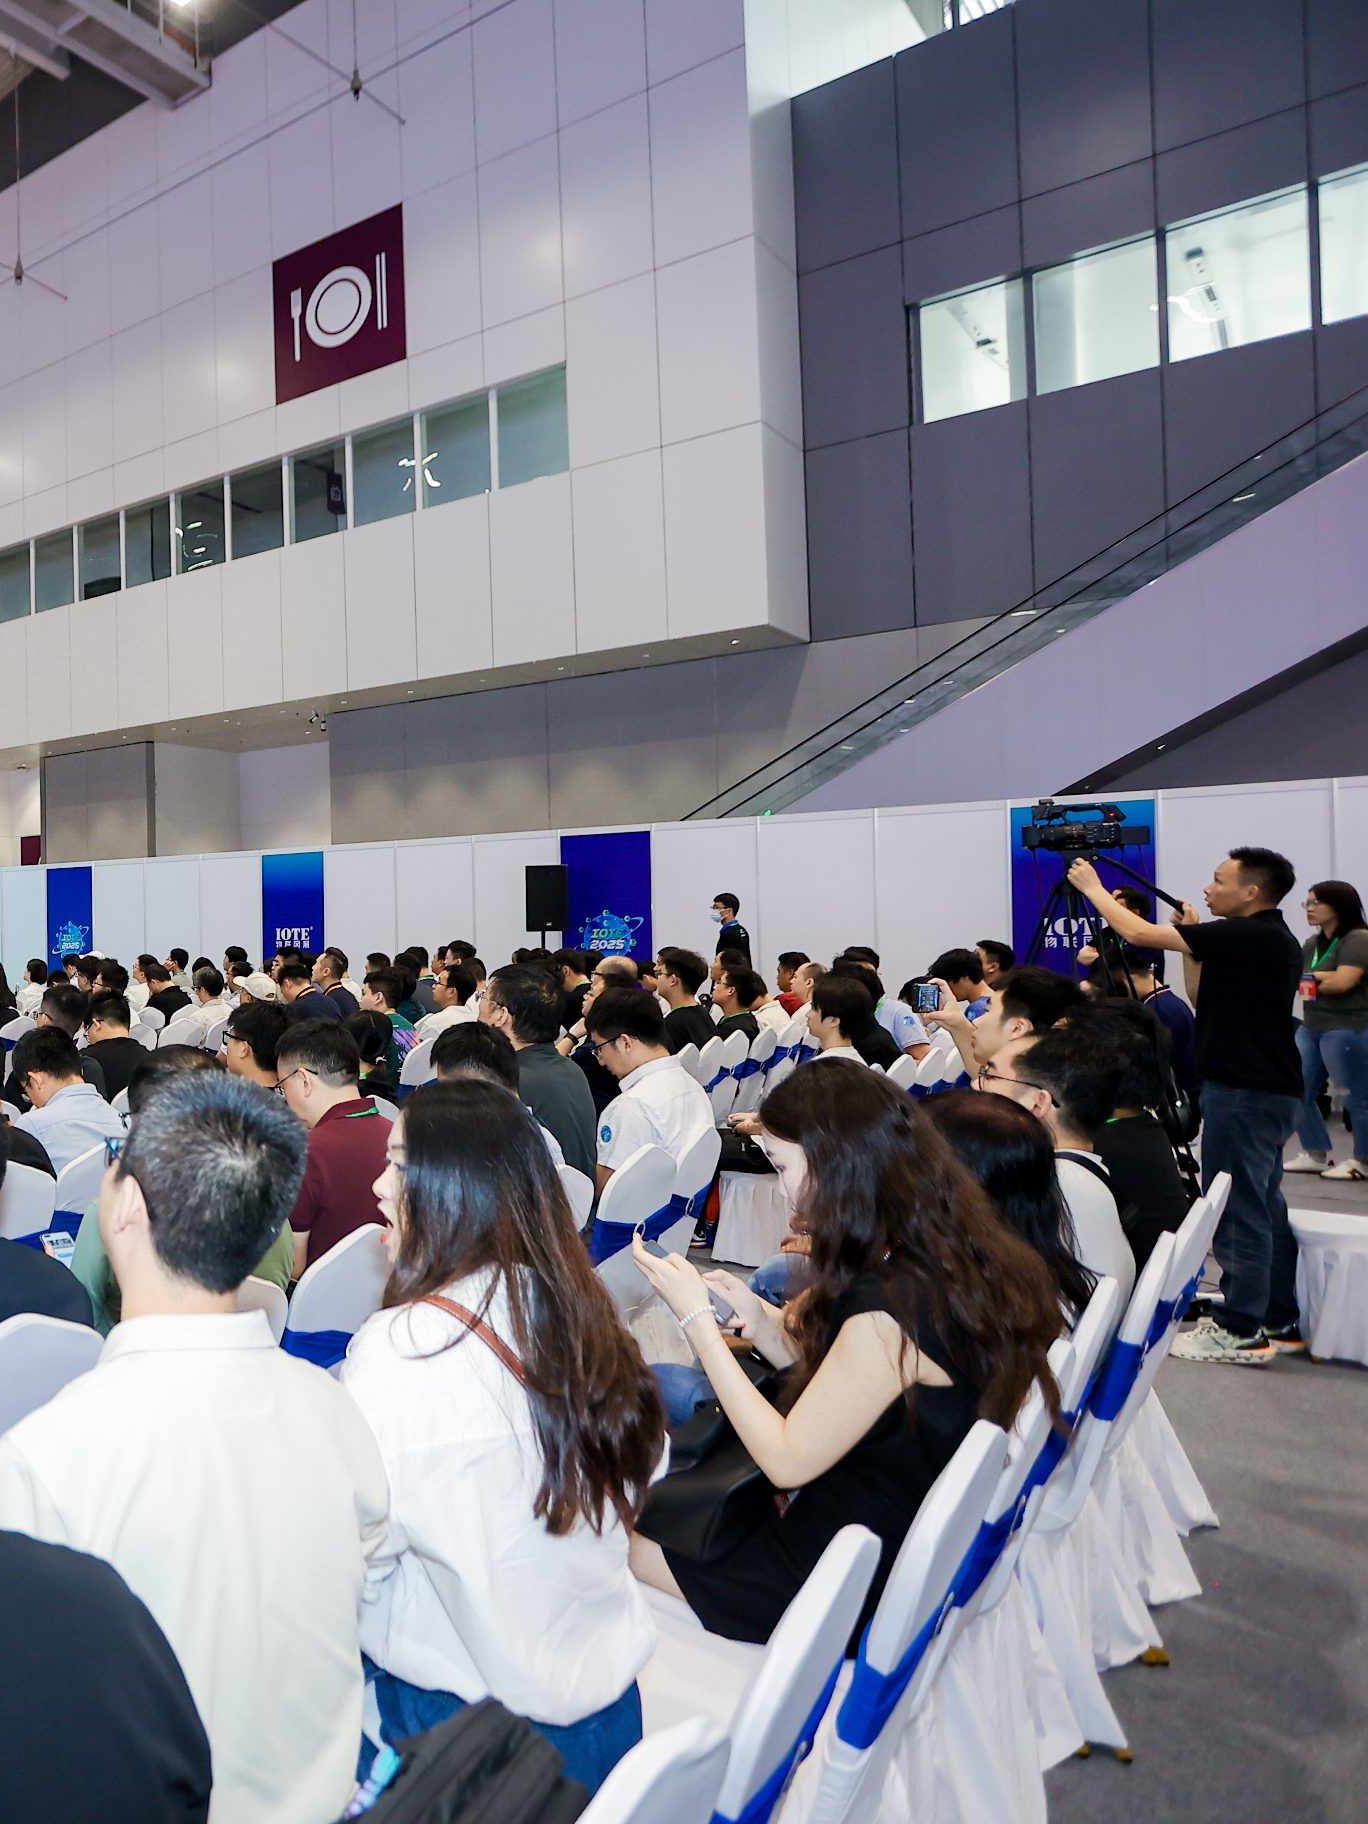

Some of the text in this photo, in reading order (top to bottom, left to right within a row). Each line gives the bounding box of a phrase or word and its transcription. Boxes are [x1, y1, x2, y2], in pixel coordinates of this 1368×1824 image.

[276, 928, 310, 940] IOTE
[590, 928, 625, 938] IOTE
[590, 940, 626, 950] 2025
